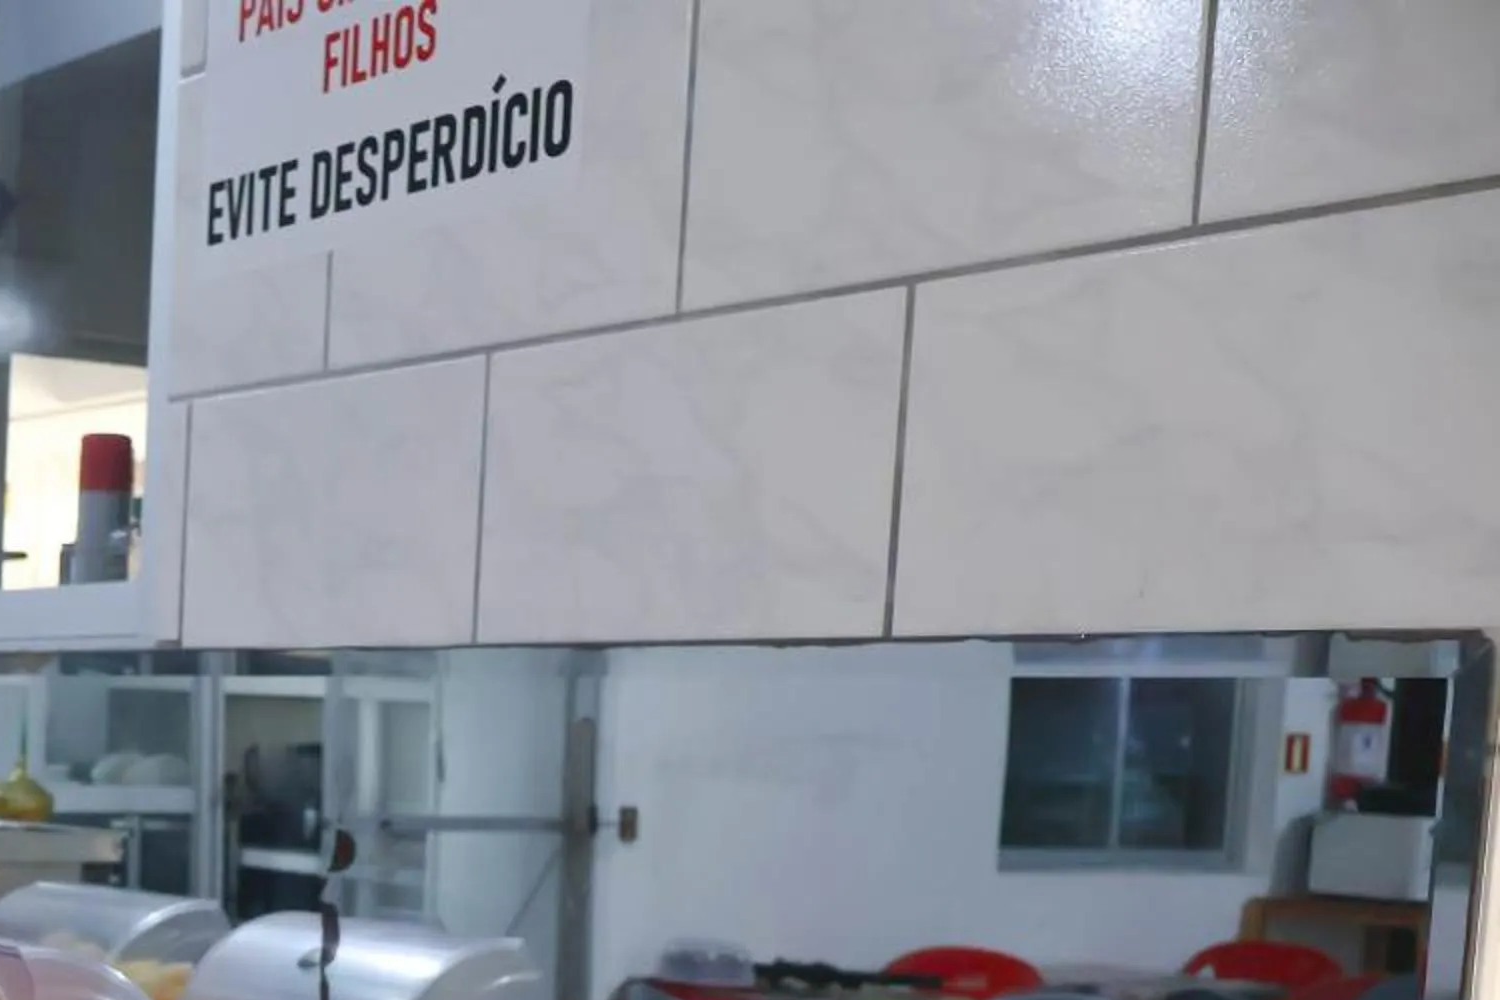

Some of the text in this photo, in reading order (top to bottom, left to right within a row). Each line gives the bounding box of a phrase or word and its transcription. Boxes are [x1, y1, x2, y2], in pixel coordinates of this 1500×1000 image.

[323, 0, 437, 93] FILHOS
[207, 74, 574, 246] EVITE DESPERDÍCIO
